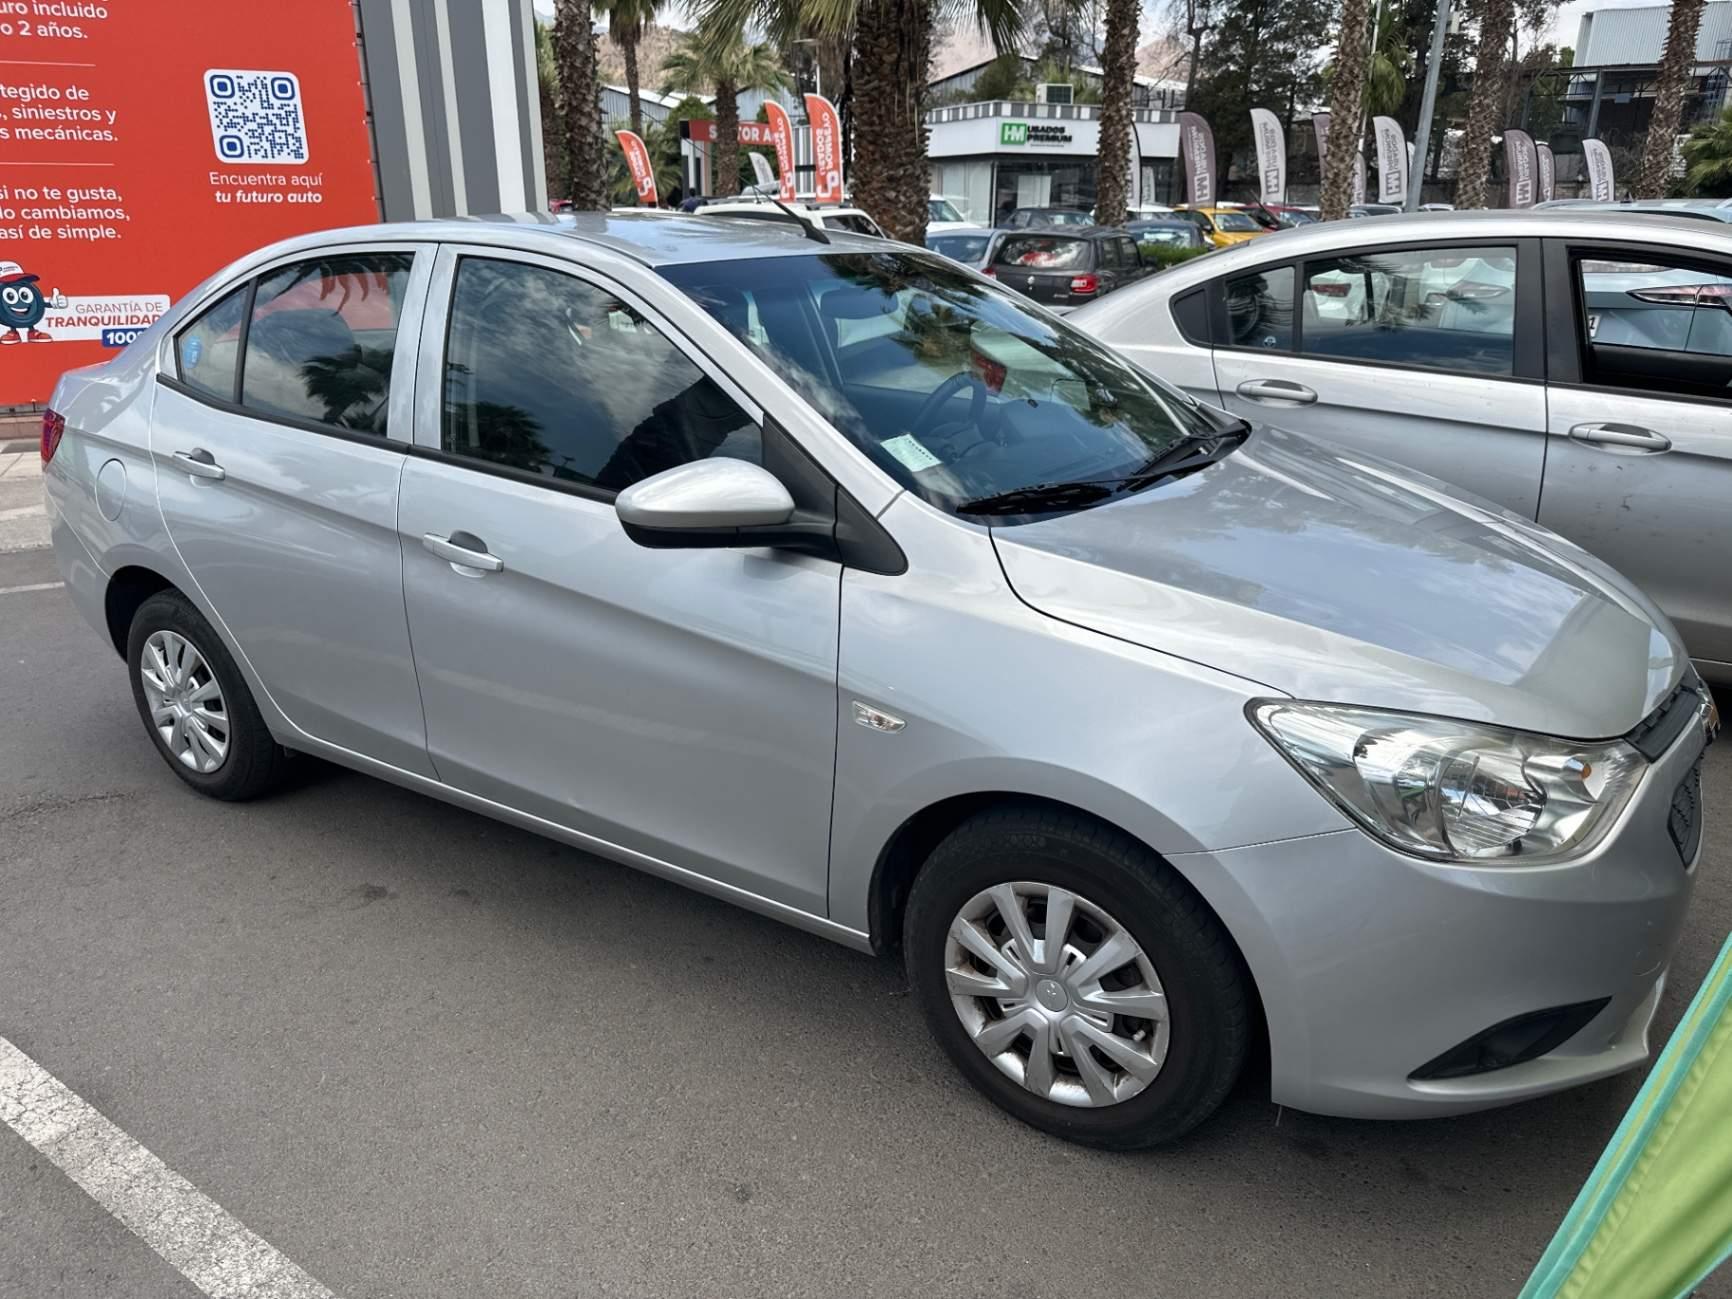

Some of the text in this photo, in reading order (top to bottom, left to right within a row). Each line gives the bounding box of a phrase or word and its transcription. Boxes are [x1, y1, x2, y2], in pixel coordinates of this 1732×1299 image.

[32, 0, 108, 18] incluido
[18, 20, 32, 36] 2
[37, 21, 88, 38] años.
[0, 83, 90, 102] tegido de
[12, 104, 101, 121] siniestros
[105, 110, 116, 125] y
[15, 124, 118, 141] mecánicas.
[708, 124, 759, 142] STOR
[1027, 134, 1072, 142] PREMIUM
[209, 172, 323, 188] Encuentra aquí
[14, 188, 38, 200] no
[43, 186, 61, 200] te
[67, 187, 122, 203] gusta,
[215, 190, 322, 203] tu futuro auto
[21, 205, 130, 221] cambiamos,
[0, 224, 122, 242] así de simple.
[75, 301, 163, 314] GARANTÍA DE
[106, 331, 141, 345] 100
